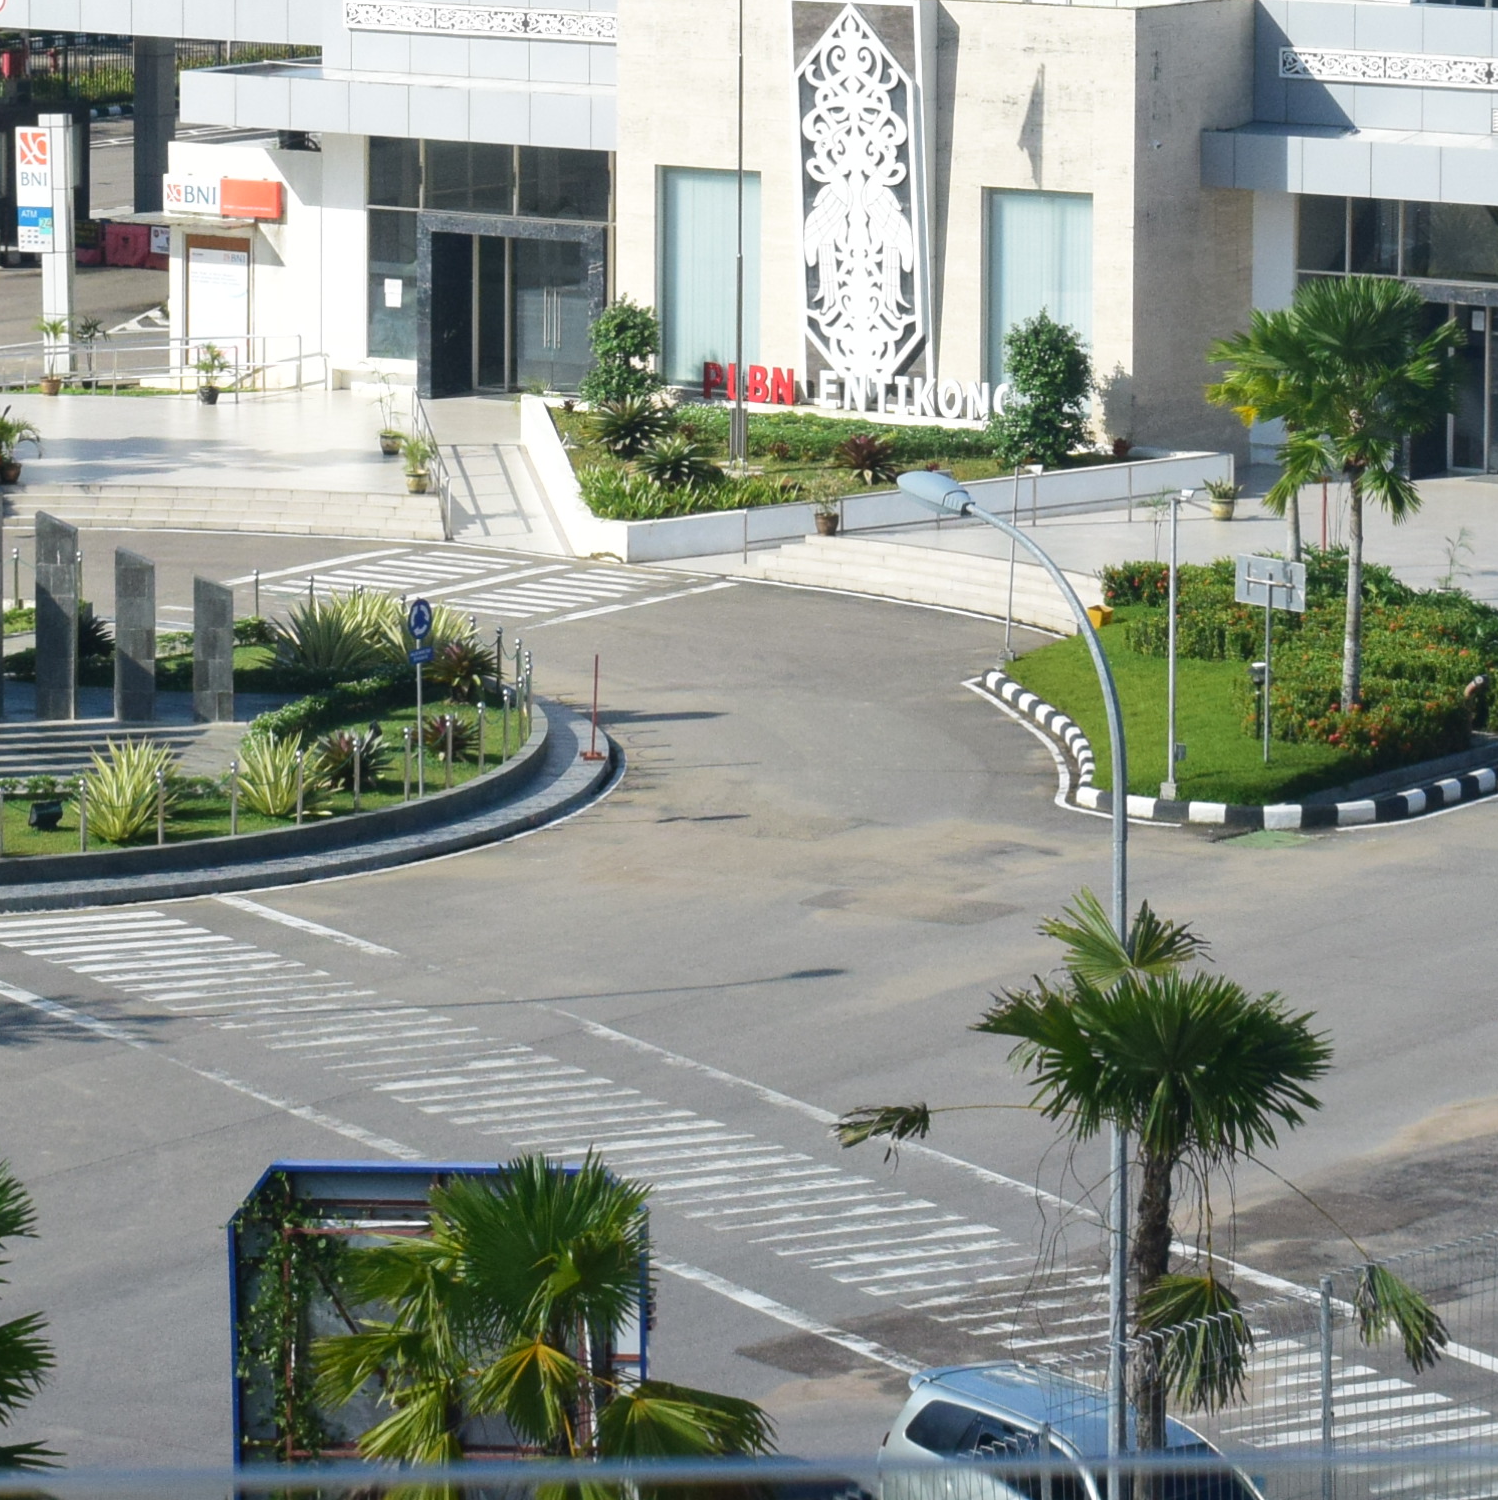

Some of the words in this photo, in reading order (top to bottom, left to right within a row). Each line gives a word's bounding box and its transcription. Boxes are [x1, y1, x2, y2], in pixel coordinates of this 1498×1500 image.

[20, 171, 48, 187] BNI
[184, 185, 217, 206] BNI
[21, 209, 38, 219] ATM
[230, 253, 246, 264] BNI
[703, 361, 794, 406] PLBN
